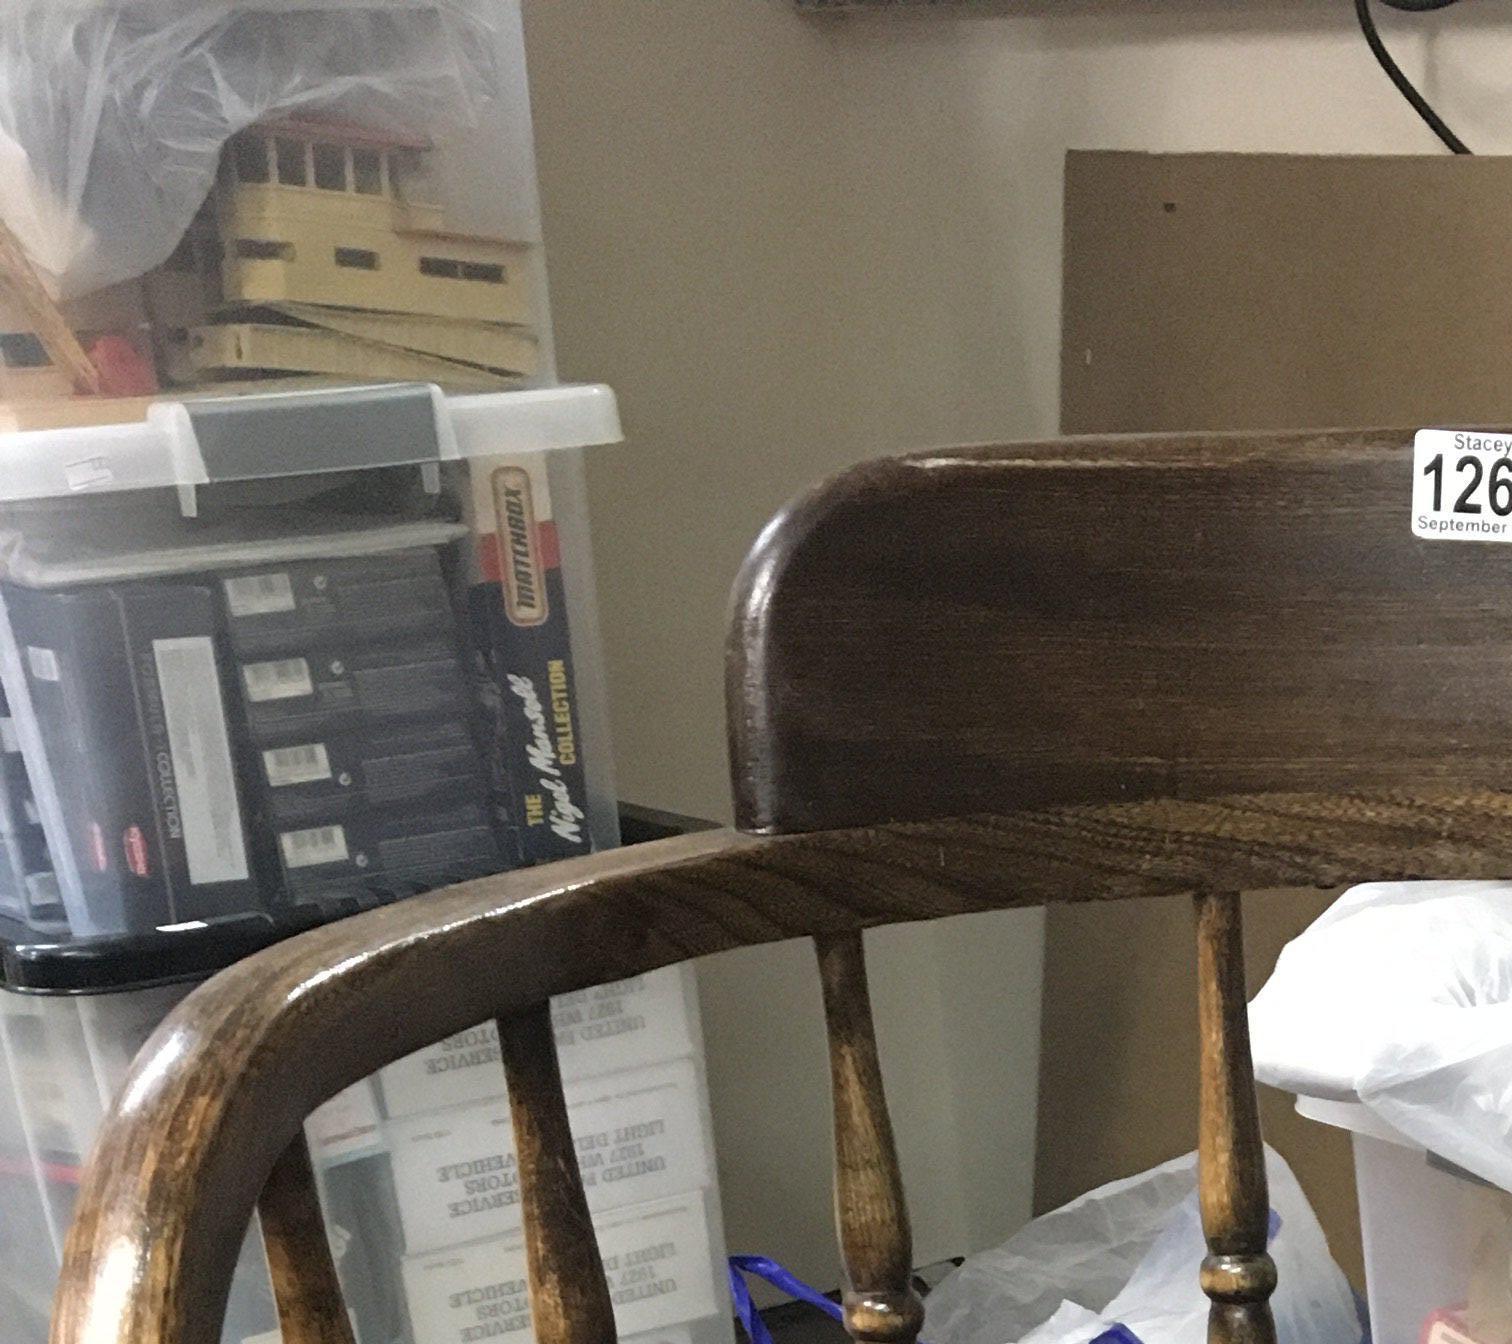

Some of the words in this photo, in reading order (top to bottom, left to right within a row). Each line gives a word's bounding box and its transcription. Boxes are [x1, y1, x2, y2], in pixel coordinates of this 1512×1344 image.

[1417, 515, 1507, 535] September
[547, 660, 576, 765] COLLECTION
[524, 794, 544, 827] THE
